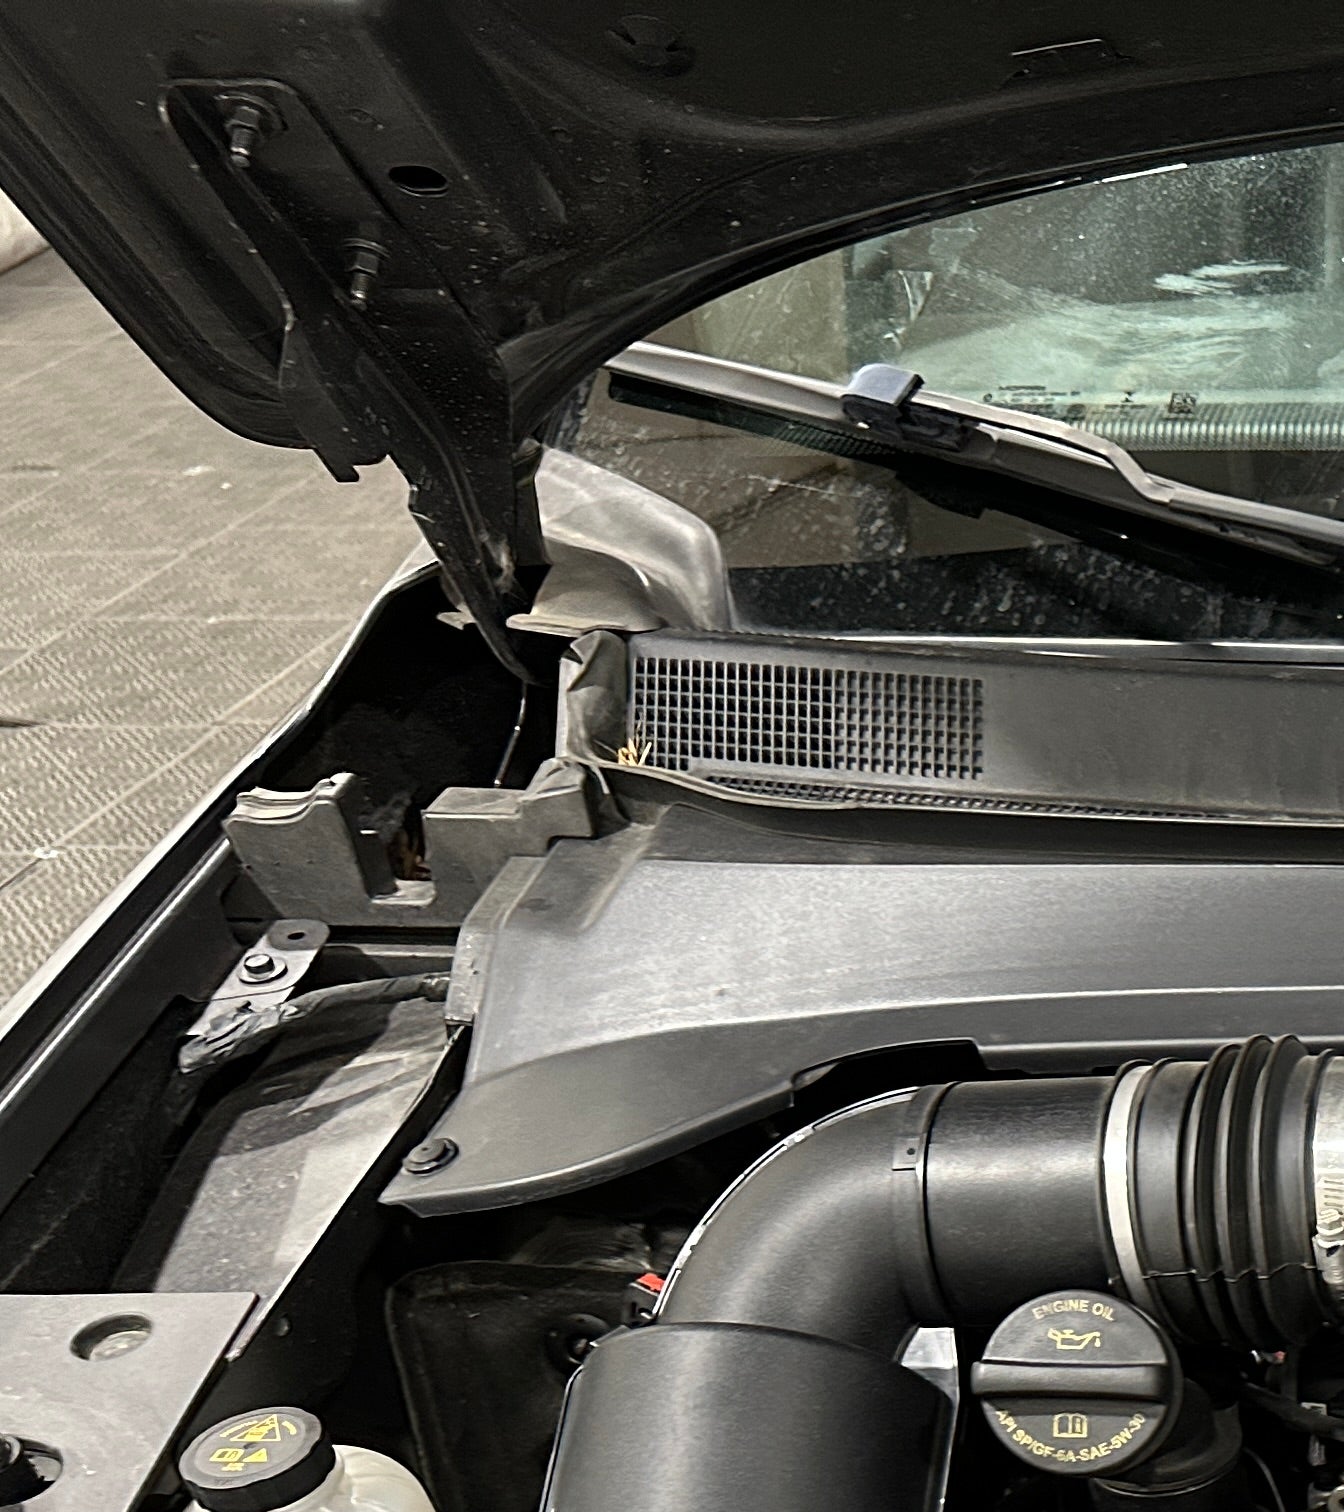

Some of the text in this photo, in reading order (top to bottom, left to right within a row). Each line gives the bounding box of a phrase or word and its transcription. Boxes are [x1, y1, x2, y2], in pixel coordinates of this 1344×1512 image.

[1032, 1299, 1115, 1321] ENGINE OIL
[995, 1410, 1017, 1433] API
